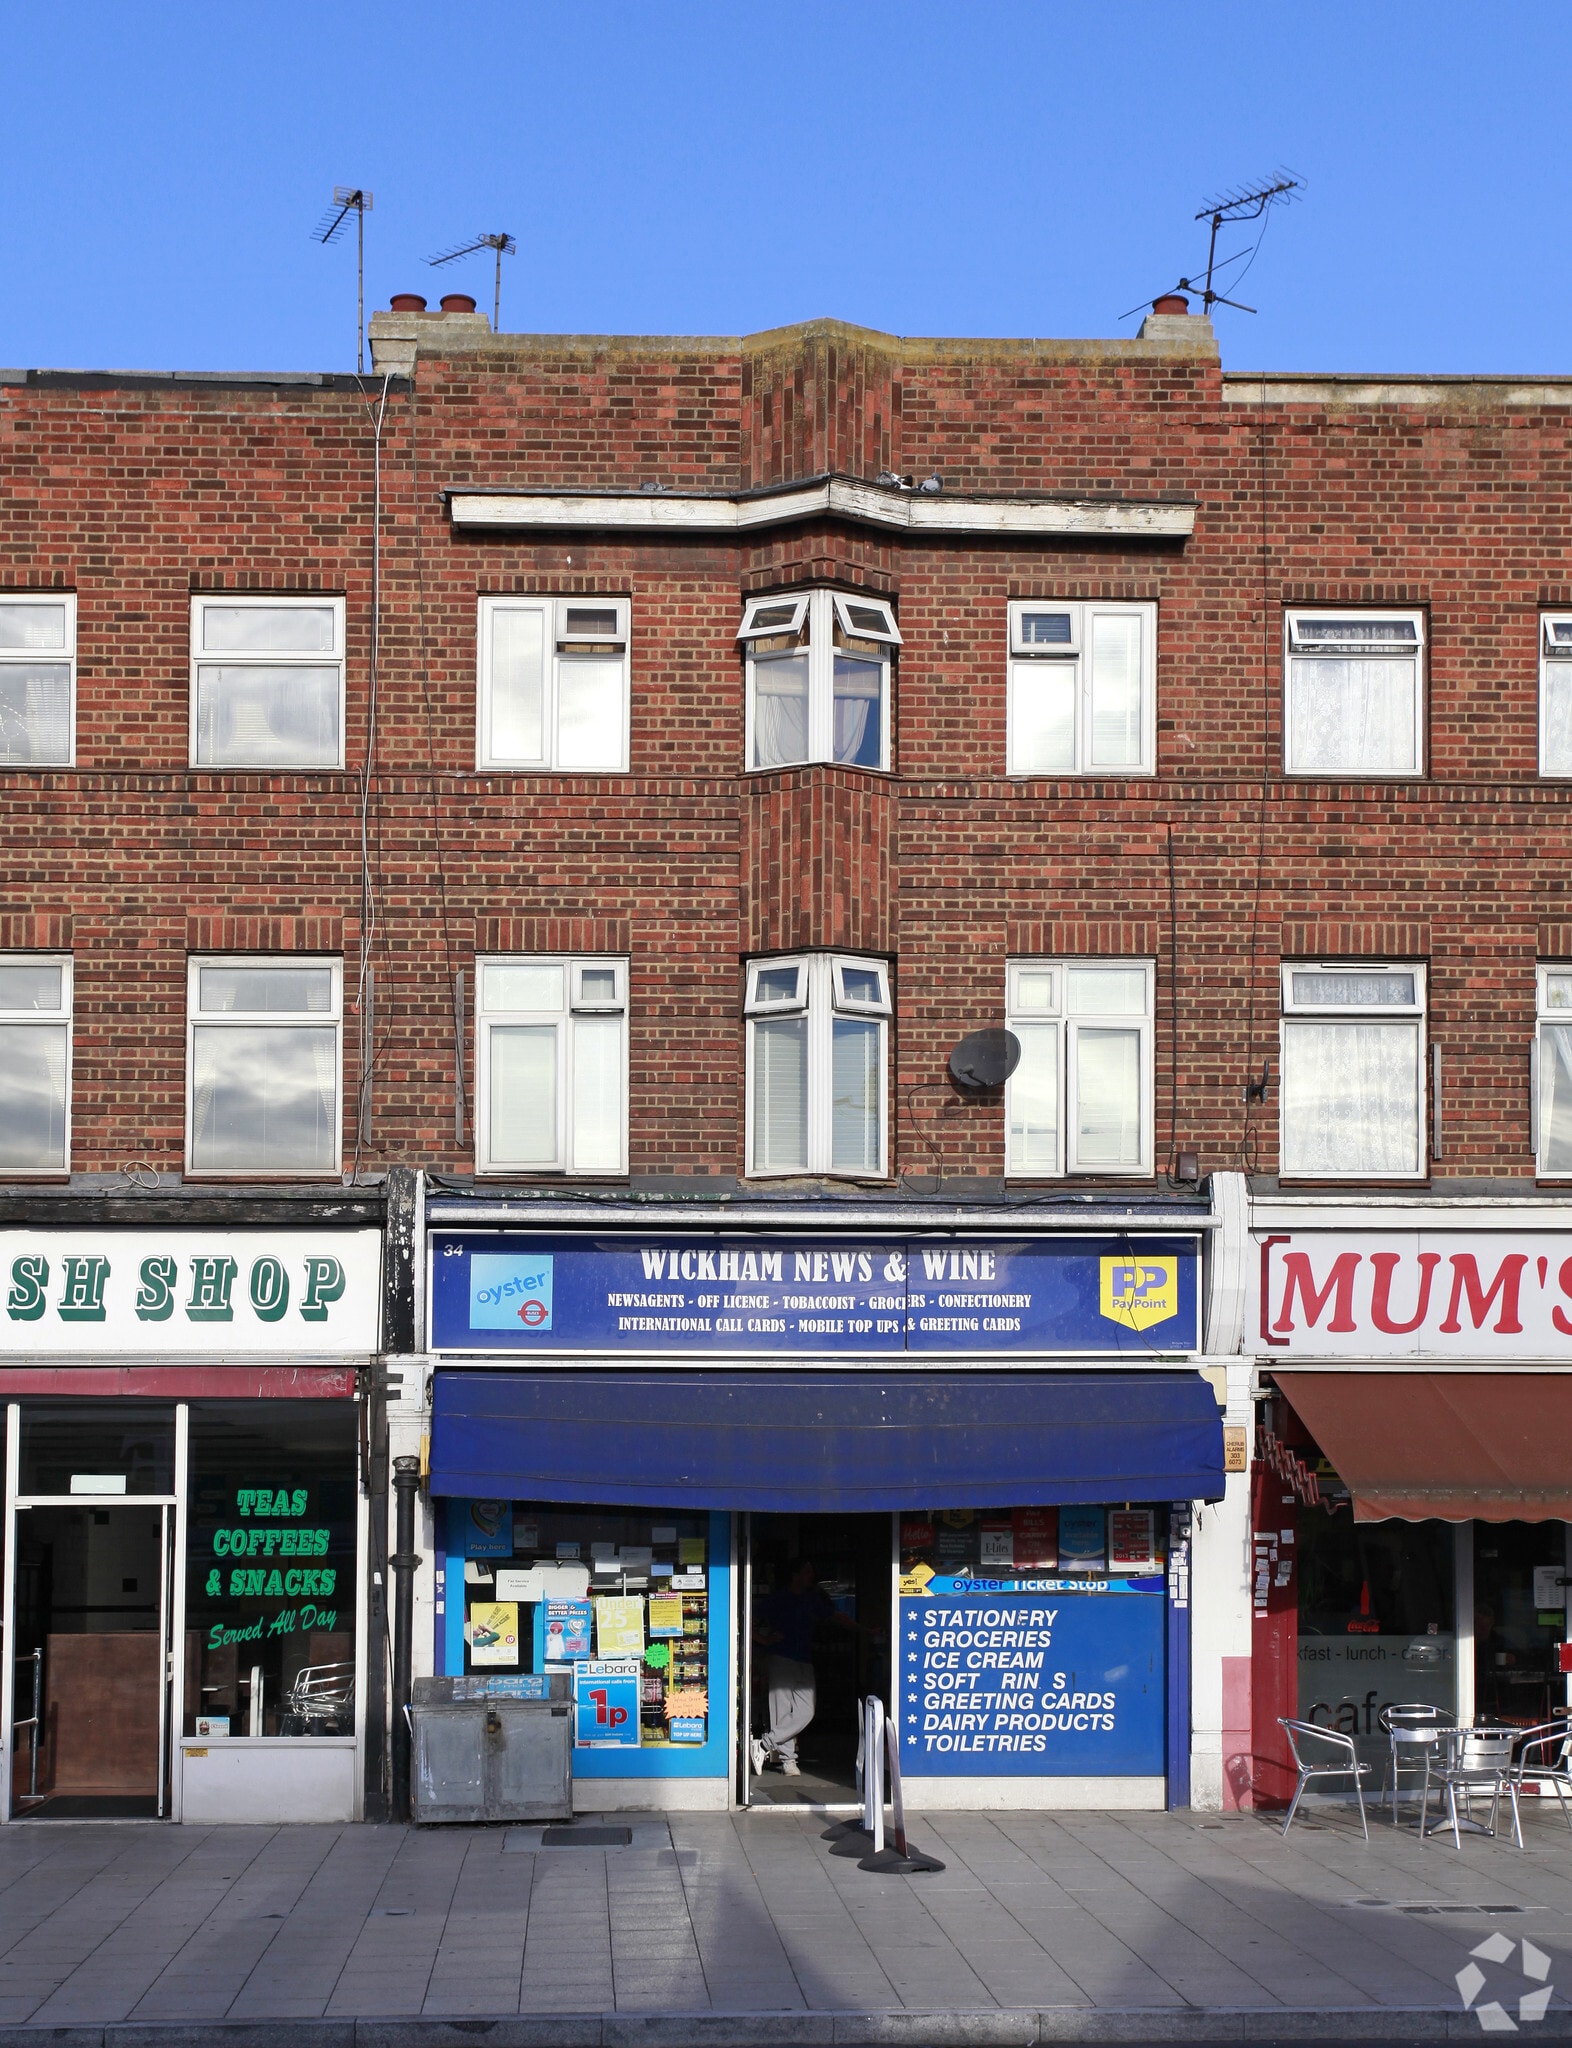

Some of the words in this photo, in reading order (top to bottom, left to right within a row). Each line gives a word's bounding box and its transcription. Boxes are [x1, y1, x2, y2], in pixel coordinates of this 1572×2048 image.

[444, 1244, 463, 1257] 34
[640, 1249, 783, 1281] WICKHAM
[794, 1251, 872, 1283] NEWS
[884, 1251, 910, 1282] &
[921, 1249, 996, 1280] WINE
[7, 1254, 111, 1322] SH
[134, 1254, 347, 1322] SHOP
[477, 1272, 546, 1305] oyster
[608, 1293, 685, 1308] NEWSAGENTS
[697, 1295, 720, 1309] OFF
[723, 1295, 770, 1309] LICENCE
[783, 1296, 856, 1310] TOBACCOIST
[868, 1294, 926, 1310] GROCERS
[938, 1294, 1031, 1308] CONFECTIONERY
[1112, 1299, 1167, 1310] PayPoint
[618, 1317, 712, 1331] INTERNATIONAL
[715, 1318, 743, 1332] CALL
[747, 1318, 786, 1332] CARDS
[799, 1319, 844, 1333] MOBILE
[848, 1319, 873, 1333] TOP
[876, 1319, 899, 1333] UPS
[903, 1317, 916, 1333] &
[919, 1317, 979, 1331] GREETING
[982, 1317, 1021, 1331] CARDS
[237, 1489, 308, 1516] TEAS
[1023, 1518, 1046, 1527] BILLS
[213, 1529, 331, 1557] COFFEES
[470, 1544, 487, 1552] Play
[205, 1568, 222, 1597] &
[229, 1568, 337, 1597] SNACKS
[953, 1580, 1005, 1592] oyster
[601, 1598, 638, 1609] Under
[207, 1616, 264, 1650] Served
[270, 1609, 296, 1635] All
[300, 1604, 337, 1632] Day
[601, 1610, 628, 1629] 25
[923, 1610, 1059, 1627] STATIONERY
[923, 1631, 1052, 1648] GROCERIES
[923, 1652, 960, 1669] ICE
[966, 1652, 1045, 1669] CREAM
[1346, 1646, 1386, 1661] lunch
[589, 1663, 638, 1675] Lebara
[923, 1672, 981, 1690] SOFT
[588, 1688, 629, 1729] 1p
[923, 1692, 1034, 1710] GREETING
[1041, 1692, 1116, 1710] CARDS
[679, 1721, 703, 1729] Lebara
[923, 1713, 989, 1731] DAIRY
[994, 1713, 1115, 1731] PRODUCTS
[924, 1734, 1047, 1752] TOILETRIES
